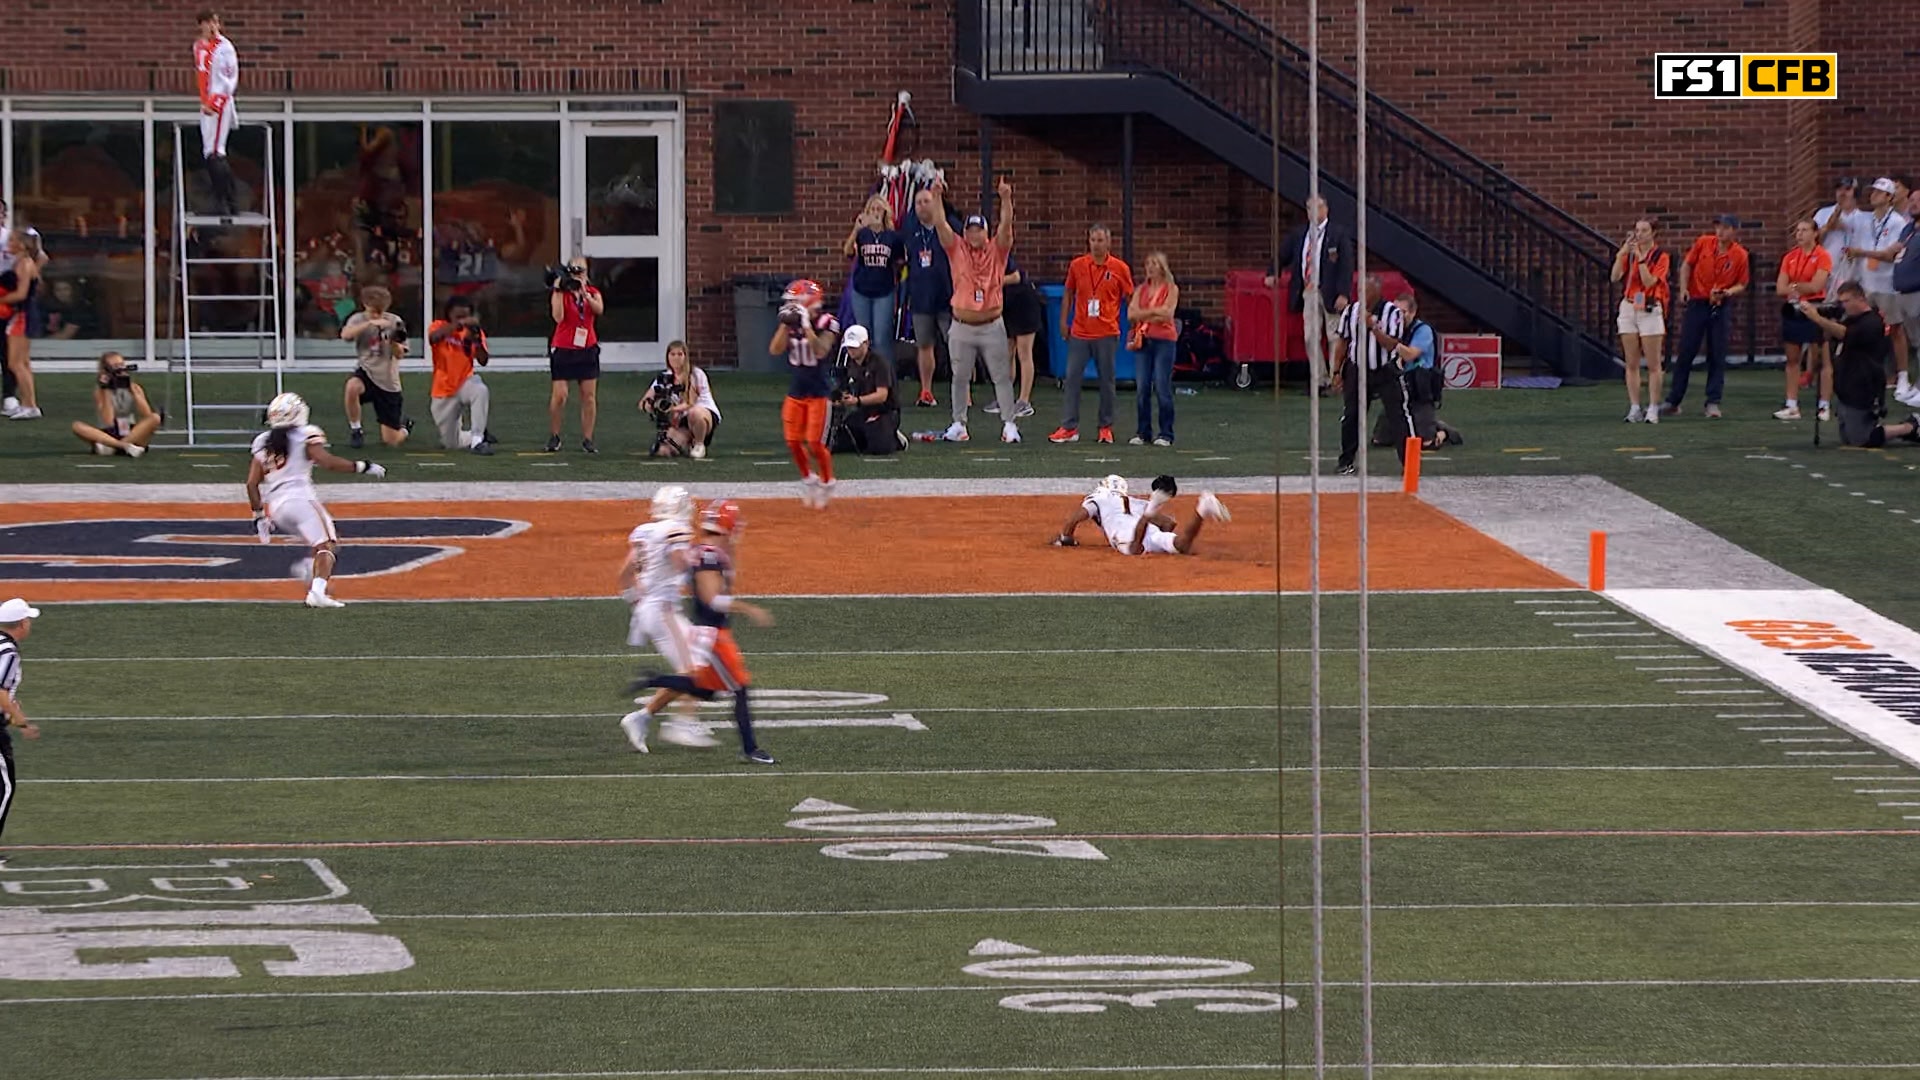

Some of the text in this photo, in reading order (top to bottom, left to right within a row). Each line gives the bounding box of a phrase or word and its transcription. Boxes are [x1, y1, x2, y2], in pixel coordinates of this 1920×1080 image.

[1120, 495, 1133, 515] 1
[1724, 619, 1876, 650] GIES
[784, 811, 1110, 862] 20
[961, 954, 1299, 1013] 30
